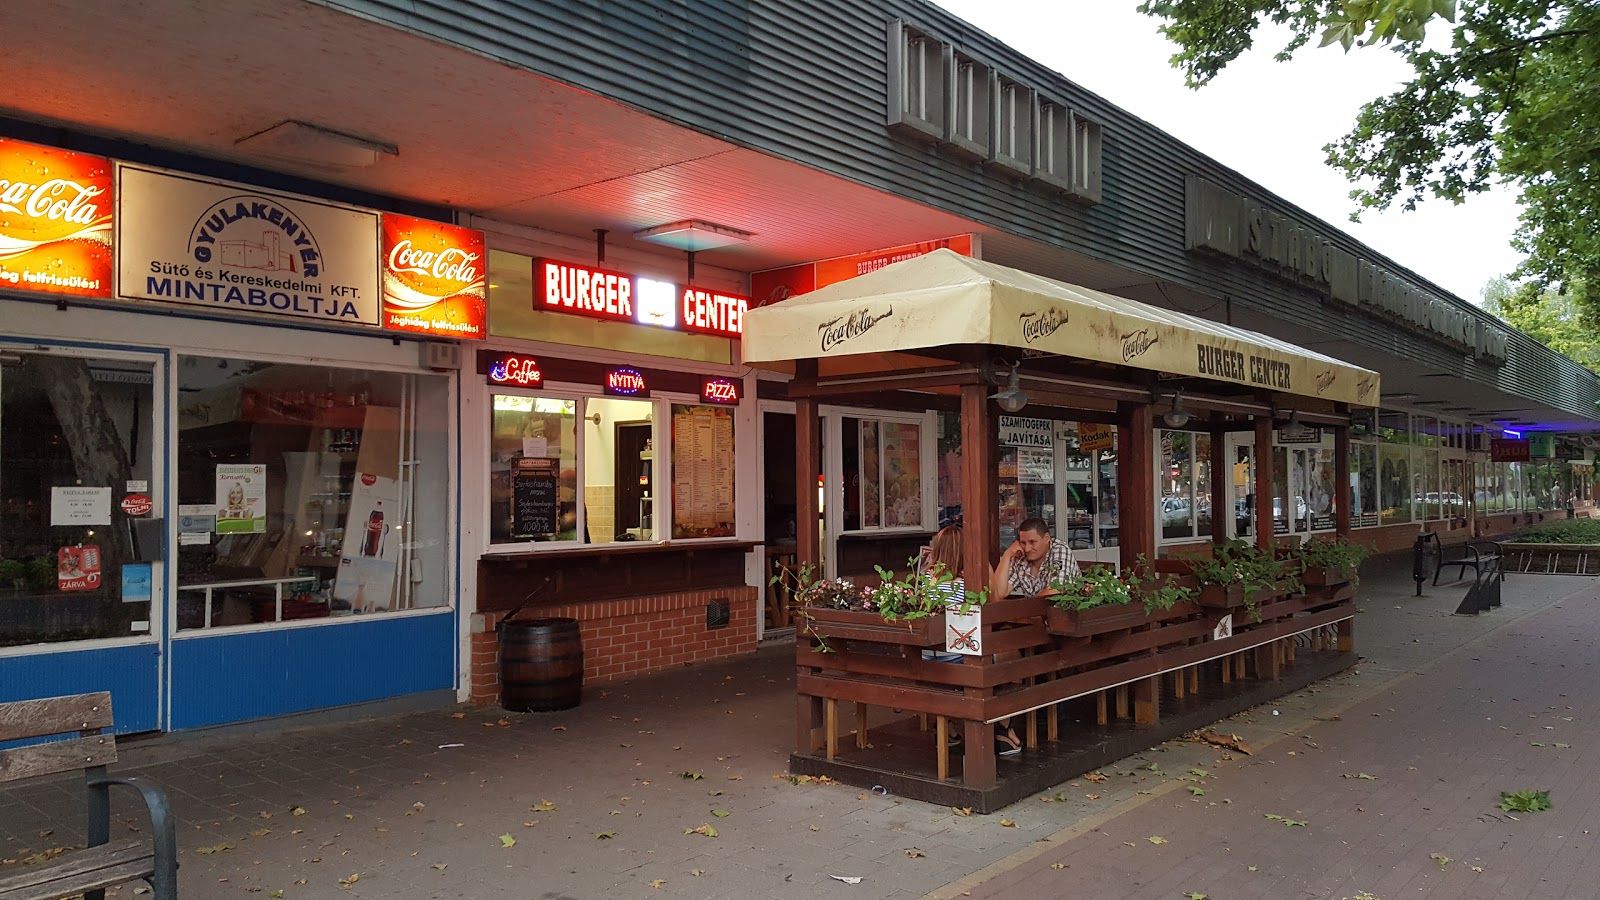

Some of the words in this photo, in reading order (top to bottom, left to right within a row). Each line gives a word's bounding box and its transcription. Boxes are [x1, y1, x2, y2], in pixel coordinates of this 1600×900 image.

[194, 201, 319, 279] GYULAKENYÉR
[389, 240, 480, 282] Coca-Cola
[150, 261, 189, 277] Sütő
[195, 266, 213, 280] és
[220, 270, 322, 294] Kereskedelmi
[331, 285, 360, 299] KFT.
[545, 263, 632, 316] BURGER
[147, 276, 359, 319] MINTABOLTJA
[505, 358, 540, 384] Coffee
[609, 372, 645, 389] NYITVA
[1197, 344, 1245, 381] BURGER
[1250, 355, 1291, 389] CENTER
[705, 382, 737, 399] PIZZA
[1007, 431, 1051, 445] JAVÍTÁSA
[1078, 430, 1110, 443] Kodak
[125, 504, 149, 514] TOLNI
